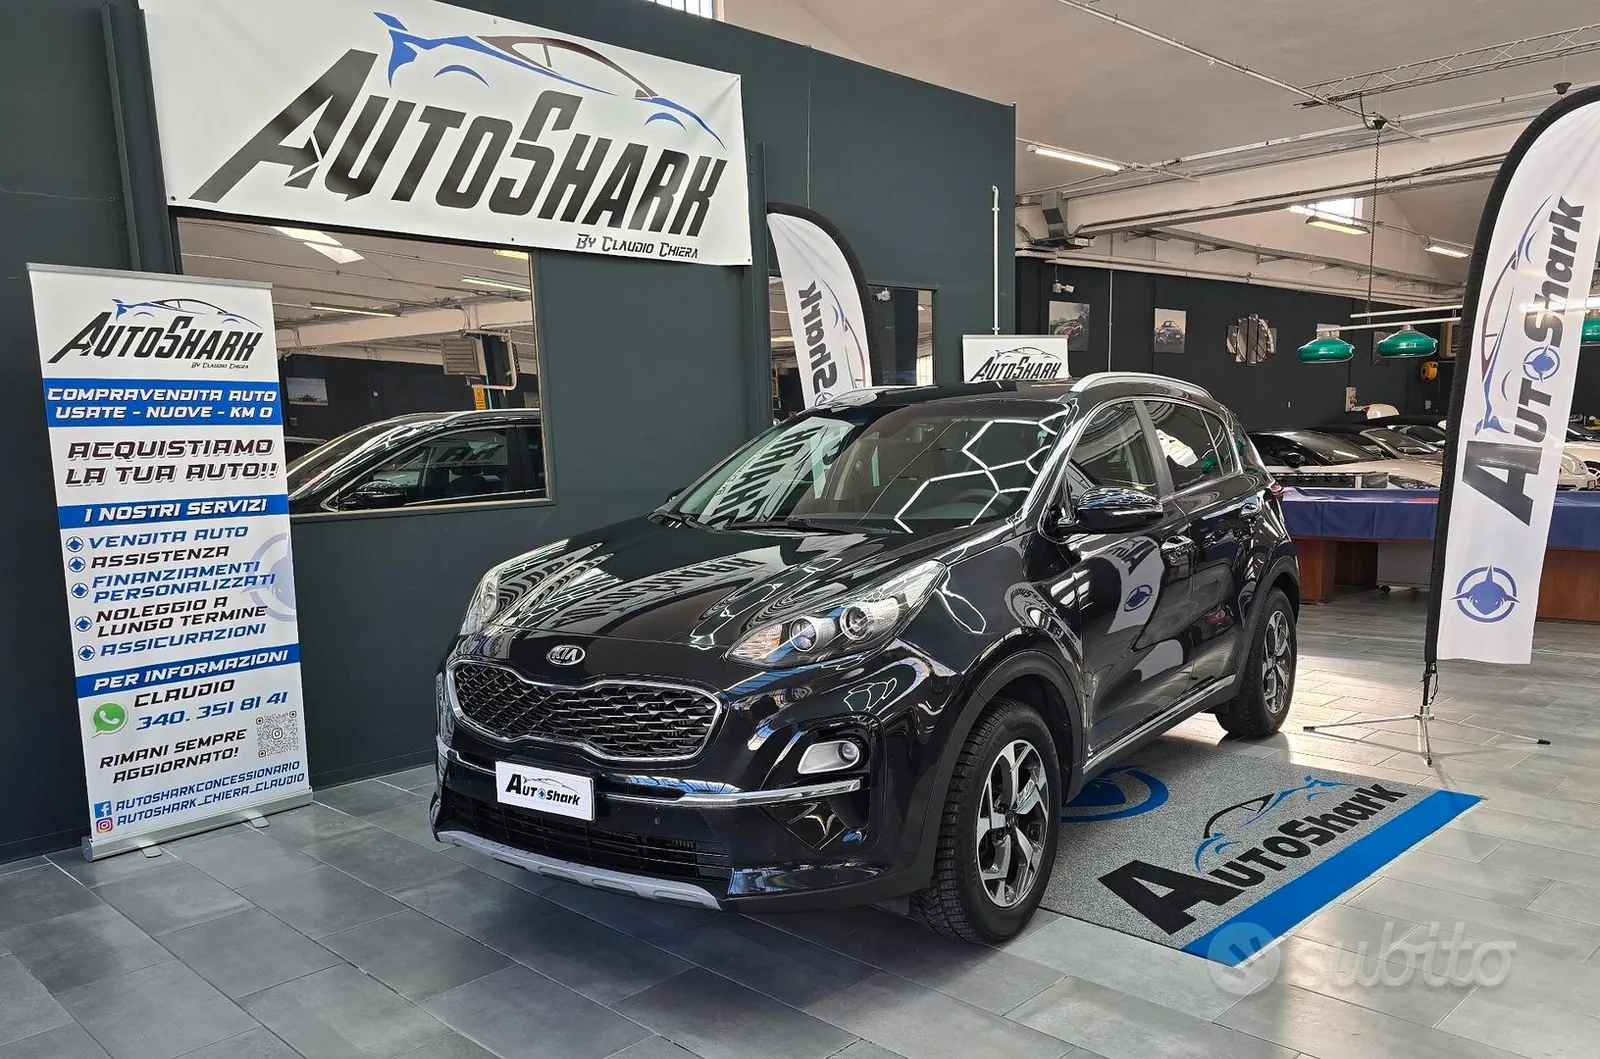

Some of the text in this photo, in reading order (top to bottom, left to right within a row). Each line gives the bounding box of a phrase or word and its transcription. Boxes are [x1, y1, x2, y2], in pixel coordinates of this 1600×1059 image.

[601, 236, 654, 254] CLAUDIO
[48, 388, 277, 402] COMPRAVENDITA AUTO
[56, 406, 126, 419] USATE
[146, 406, 212, 419] NUOVE
[230, 406, 254, 419] KM
[67, 439, 274, 462] ACQUISTIAMO
[65, 462, 278, 486] LA TUA AUTO!!
[84, 499, 267, 522] I NOSTRI SERVIZI
[88, 526, 249, 549] VENDITA AUTO
[91, 546, 229, 569] ASSISTENZA
[92, 562, 260, 588] FINANZIAMENTI
[94, 574, 276, 603] PERSONALIZZATI
[96, 596, 229, 623] NOLEGGIO A
[97, 606, 268, 638] LUNGO TERMINE
[100, 623, 266, 657] ASSICURAZIONI
[93, 651, 288, 692] PER INFORMAZIONI
[134, 680, 235, 708] CLAUDIO
[197, 702, 235, 720] 351
[240, 697, 261, 713] 81
[266, 691, 288, 706] 41
[100, 729, 247, 769] RIMANI SEMPRE
[113, 748, 239, 784] AGGIORNATO!
[116, 761, 300, 812] AUTOSHARKCONCESSIONARIO
[117, 773, 305, 826] AUTOSHARK_CHIERA_CLAUDIO
